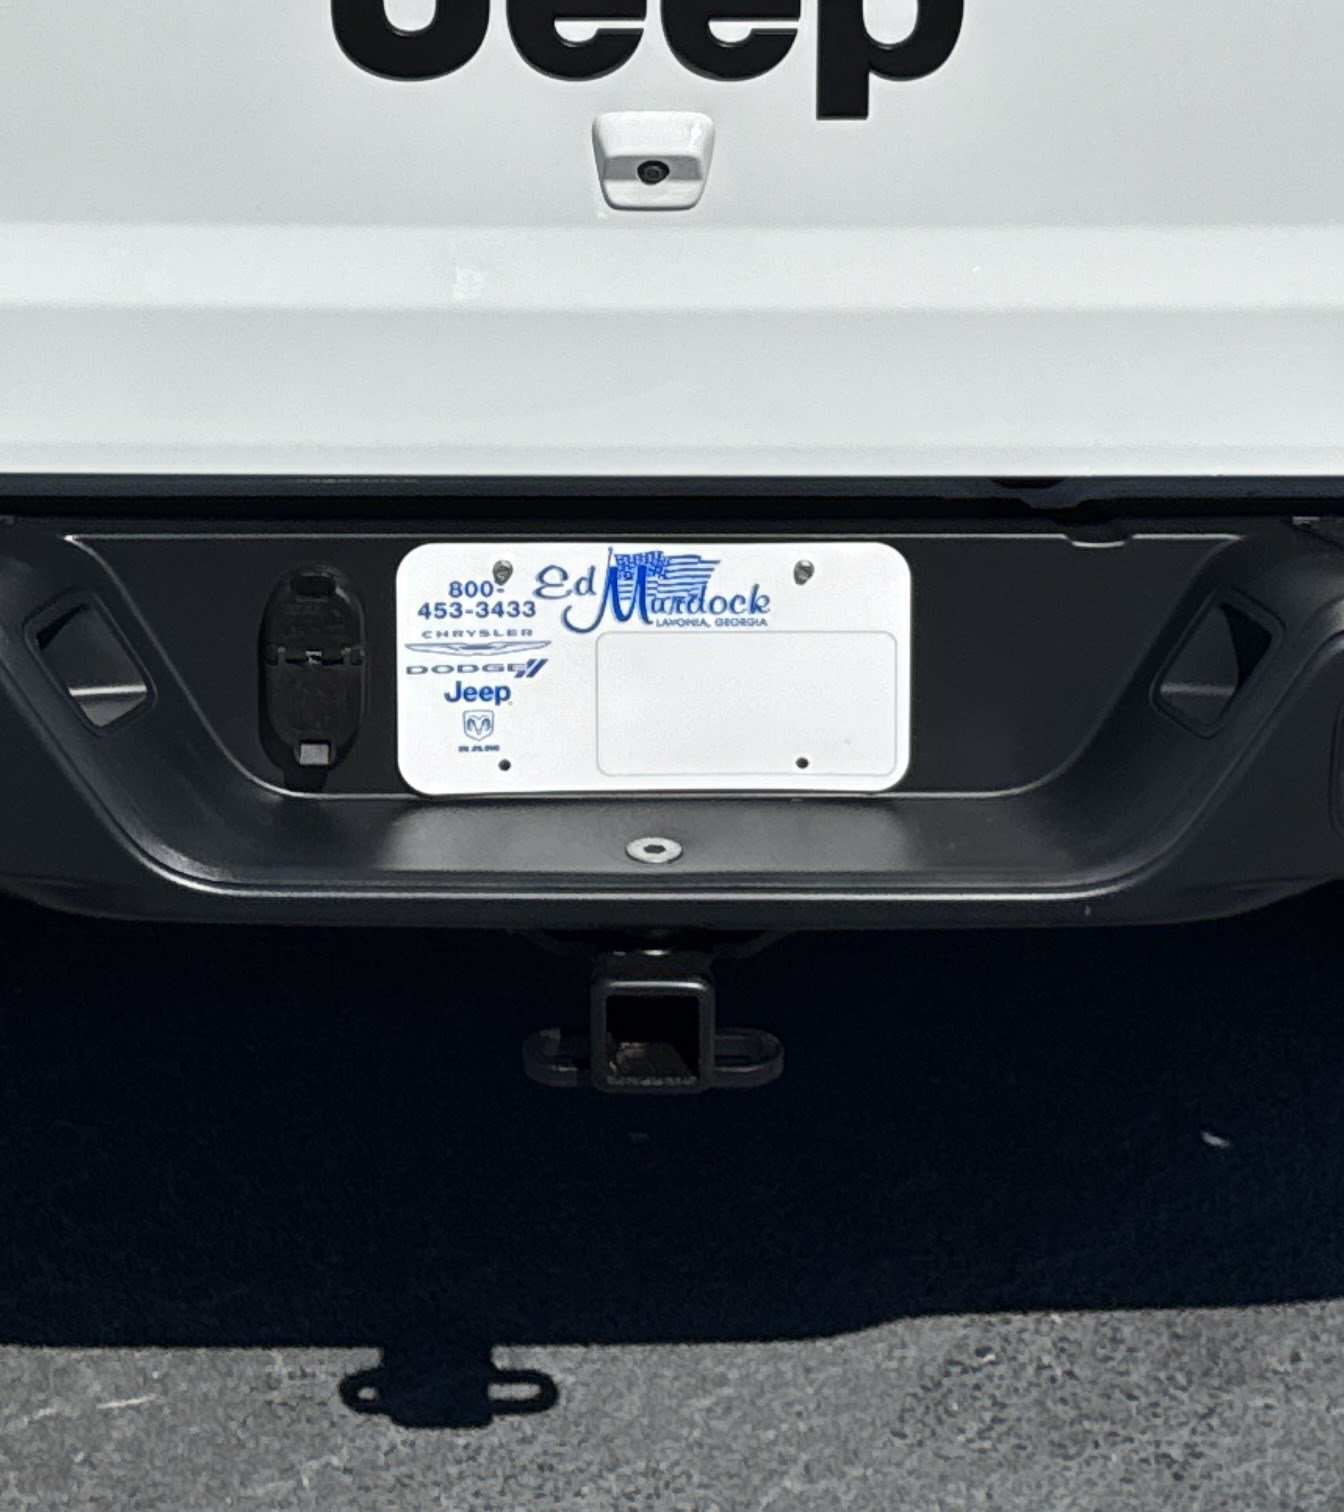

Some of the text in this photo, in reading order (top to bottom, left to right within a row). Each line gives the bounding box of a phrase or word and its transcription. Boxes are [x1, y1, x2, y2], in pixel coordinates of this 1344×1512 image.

[448, 580, 505, 598] 800-
[533, 564, 770, 633] Ed Murdock
[418, 600, 536, 619] 453-3433
[715, 618, 768, 628] GEORGIA
[421, 629, 533, 639] CHRYSLER
[406, 662, 526, 676] DODGE
[444, 680, 512, 706] Jeep
